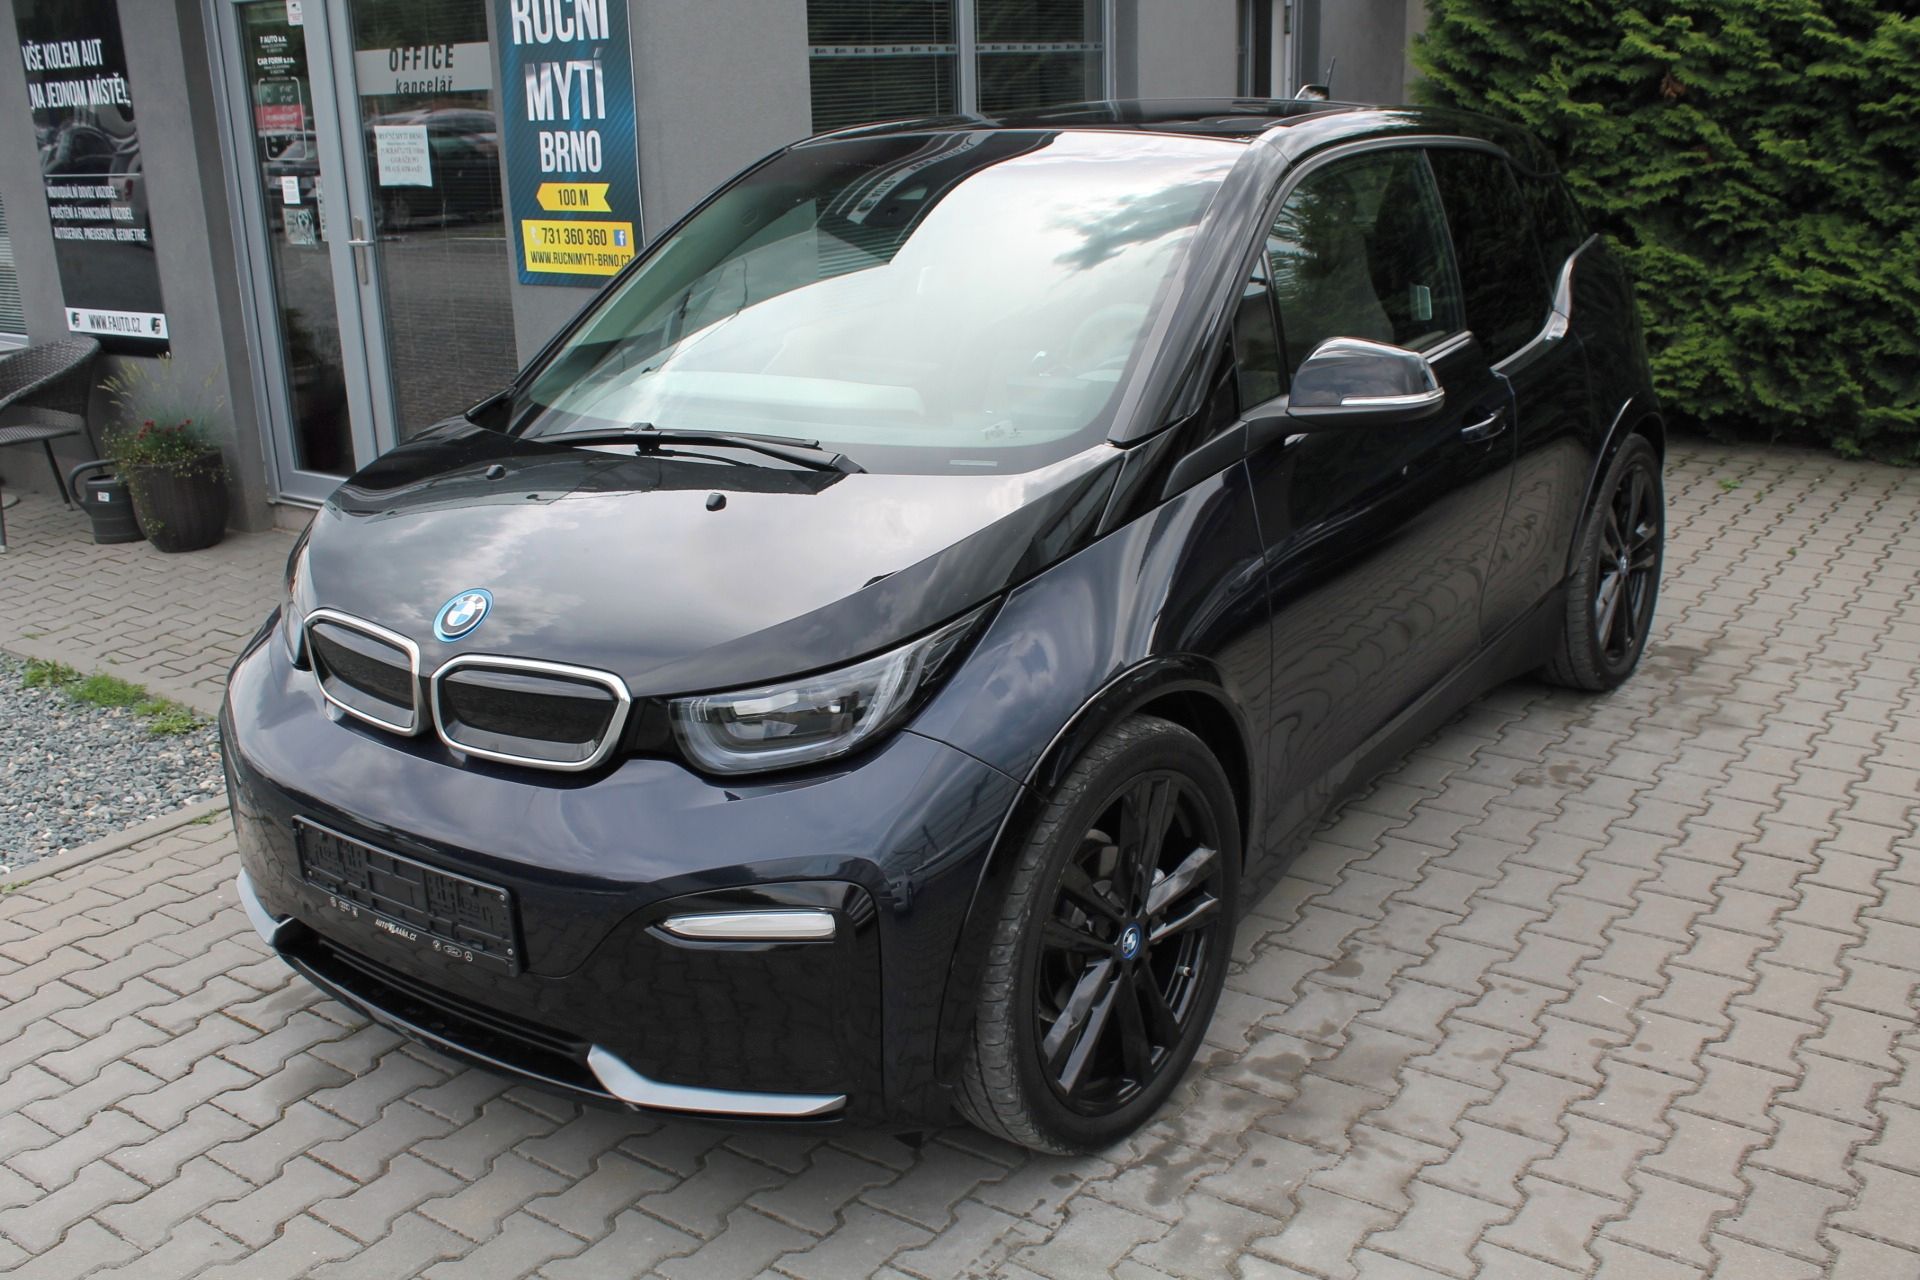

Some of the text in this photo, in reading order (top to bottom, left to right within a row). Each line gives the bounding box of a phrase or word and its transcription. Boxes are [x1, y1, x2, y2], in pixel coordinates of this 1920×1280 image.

[22, 38, 103, 71] VŠE KOLEM AUT
[389, 45, 453, 72] OFFICE
[45, 80, 87, 107] JEDNOM
[396, 75, 453, 96] kancelář
[525, 47, 606, 121] MYTÍ
[539, 129, 602, 173] BRNO
[558, 189, 589, 206] 100 M
[541, 227, 561, 245] 731
[564, 228, 584, 245] 360
[586, 229, 607, 246] 360
[88, 314, 142, 333] WWW.FAUTO.CZ
